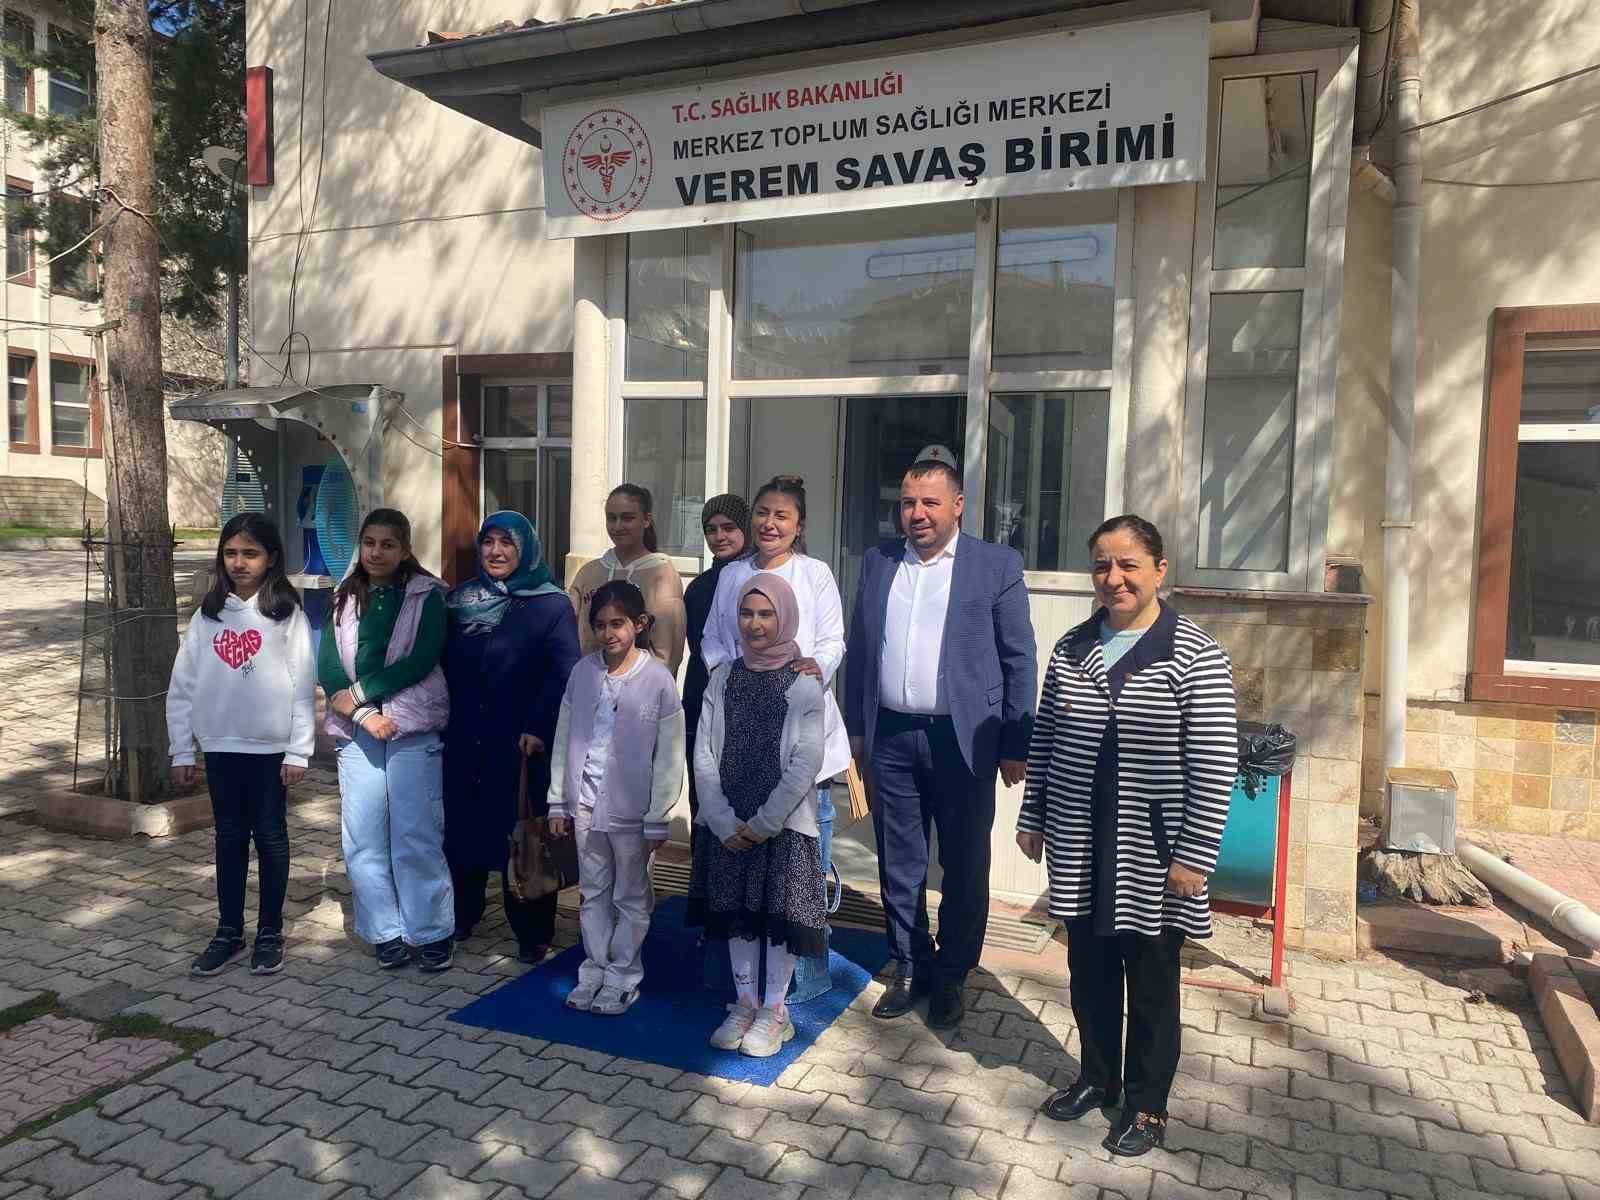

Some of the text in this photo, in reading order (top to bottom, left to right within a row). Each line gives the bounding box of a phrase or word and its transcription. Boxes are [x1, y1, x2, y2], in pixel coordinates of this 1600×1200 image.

[672, 71, 904, 124] T.C. SAĞLIK BAKANLIĞI
[673, 82, 1111, 160] MERKEZ TOPLUM SAĞLIĞI MERKEZİ
[674, 112, 1175, 206] VEREM SAVAŞ BİRİMİ
[213, 628, 239, 645] LAS
[213, 629, 263, 670] VEGAS
